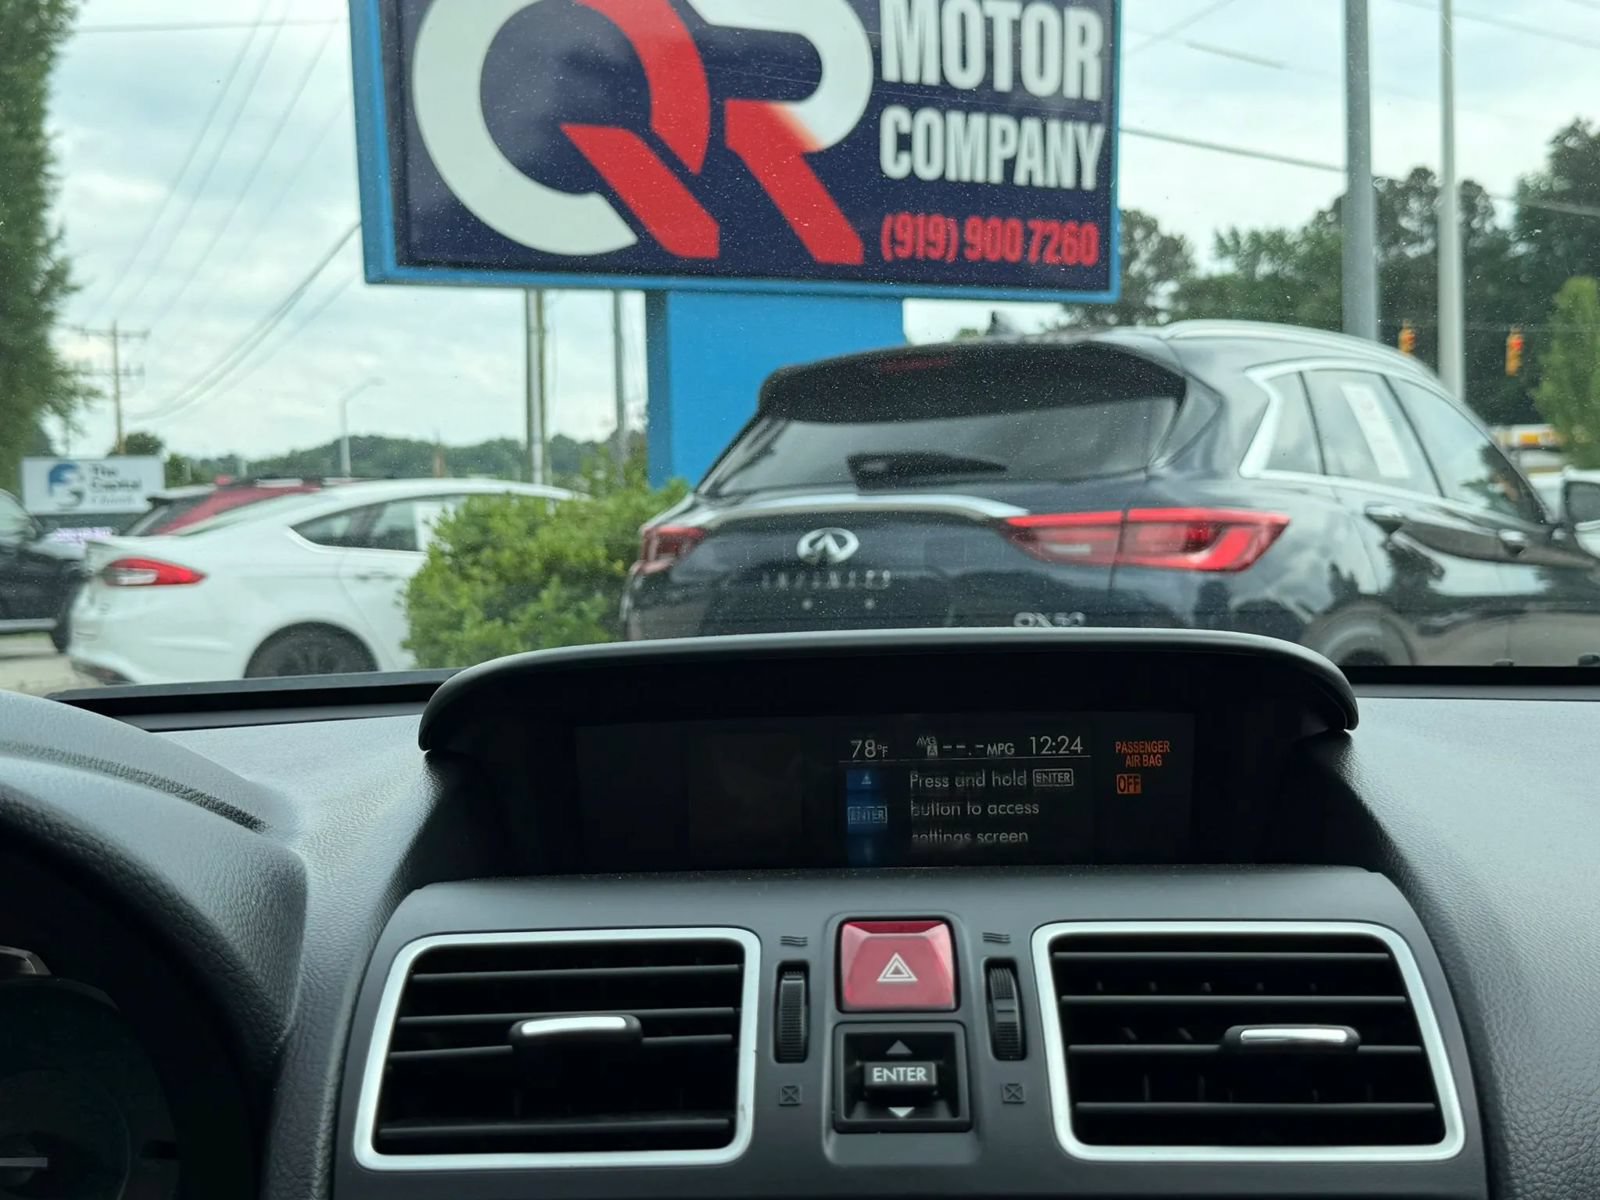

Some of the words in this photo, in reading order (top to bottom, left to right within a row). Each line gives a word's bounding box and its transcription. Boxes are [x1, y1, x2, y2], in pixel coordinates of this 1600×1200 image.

[879, 0, 1104, 101] MOTOR
[879, 104, 1106, 191] COMPANY
[880, 211, 959, 263] (919)
[964, 216, 1025, 263] 900
[1028, 218, 1099, 267] 7260
[916, 736, 937, 746] AVG
[986, 742, 1015, 755] MPG
[1030, 735, 1083, 755] 12:24
[1115, 741, 1170, 754] PASSENGER
[1125, 754, 1141, 768] AIR
[1142, 754, 1162, 767] BAG
[910, 771, 950, 788] Press
[955, 769, 986, 788] and
[992, 769, 1027, 787] hold
[1035, 772, 1071, 784] ENTER
[1118, 775, 1141, 793] OFF
[910, 800, 961, 816] button
[967, 801, 982, 815] to
[987, 803, 1040, 815] access
[977, 830, 1029, 843] screen
[872, 1067, 927, 1082] ENTER
